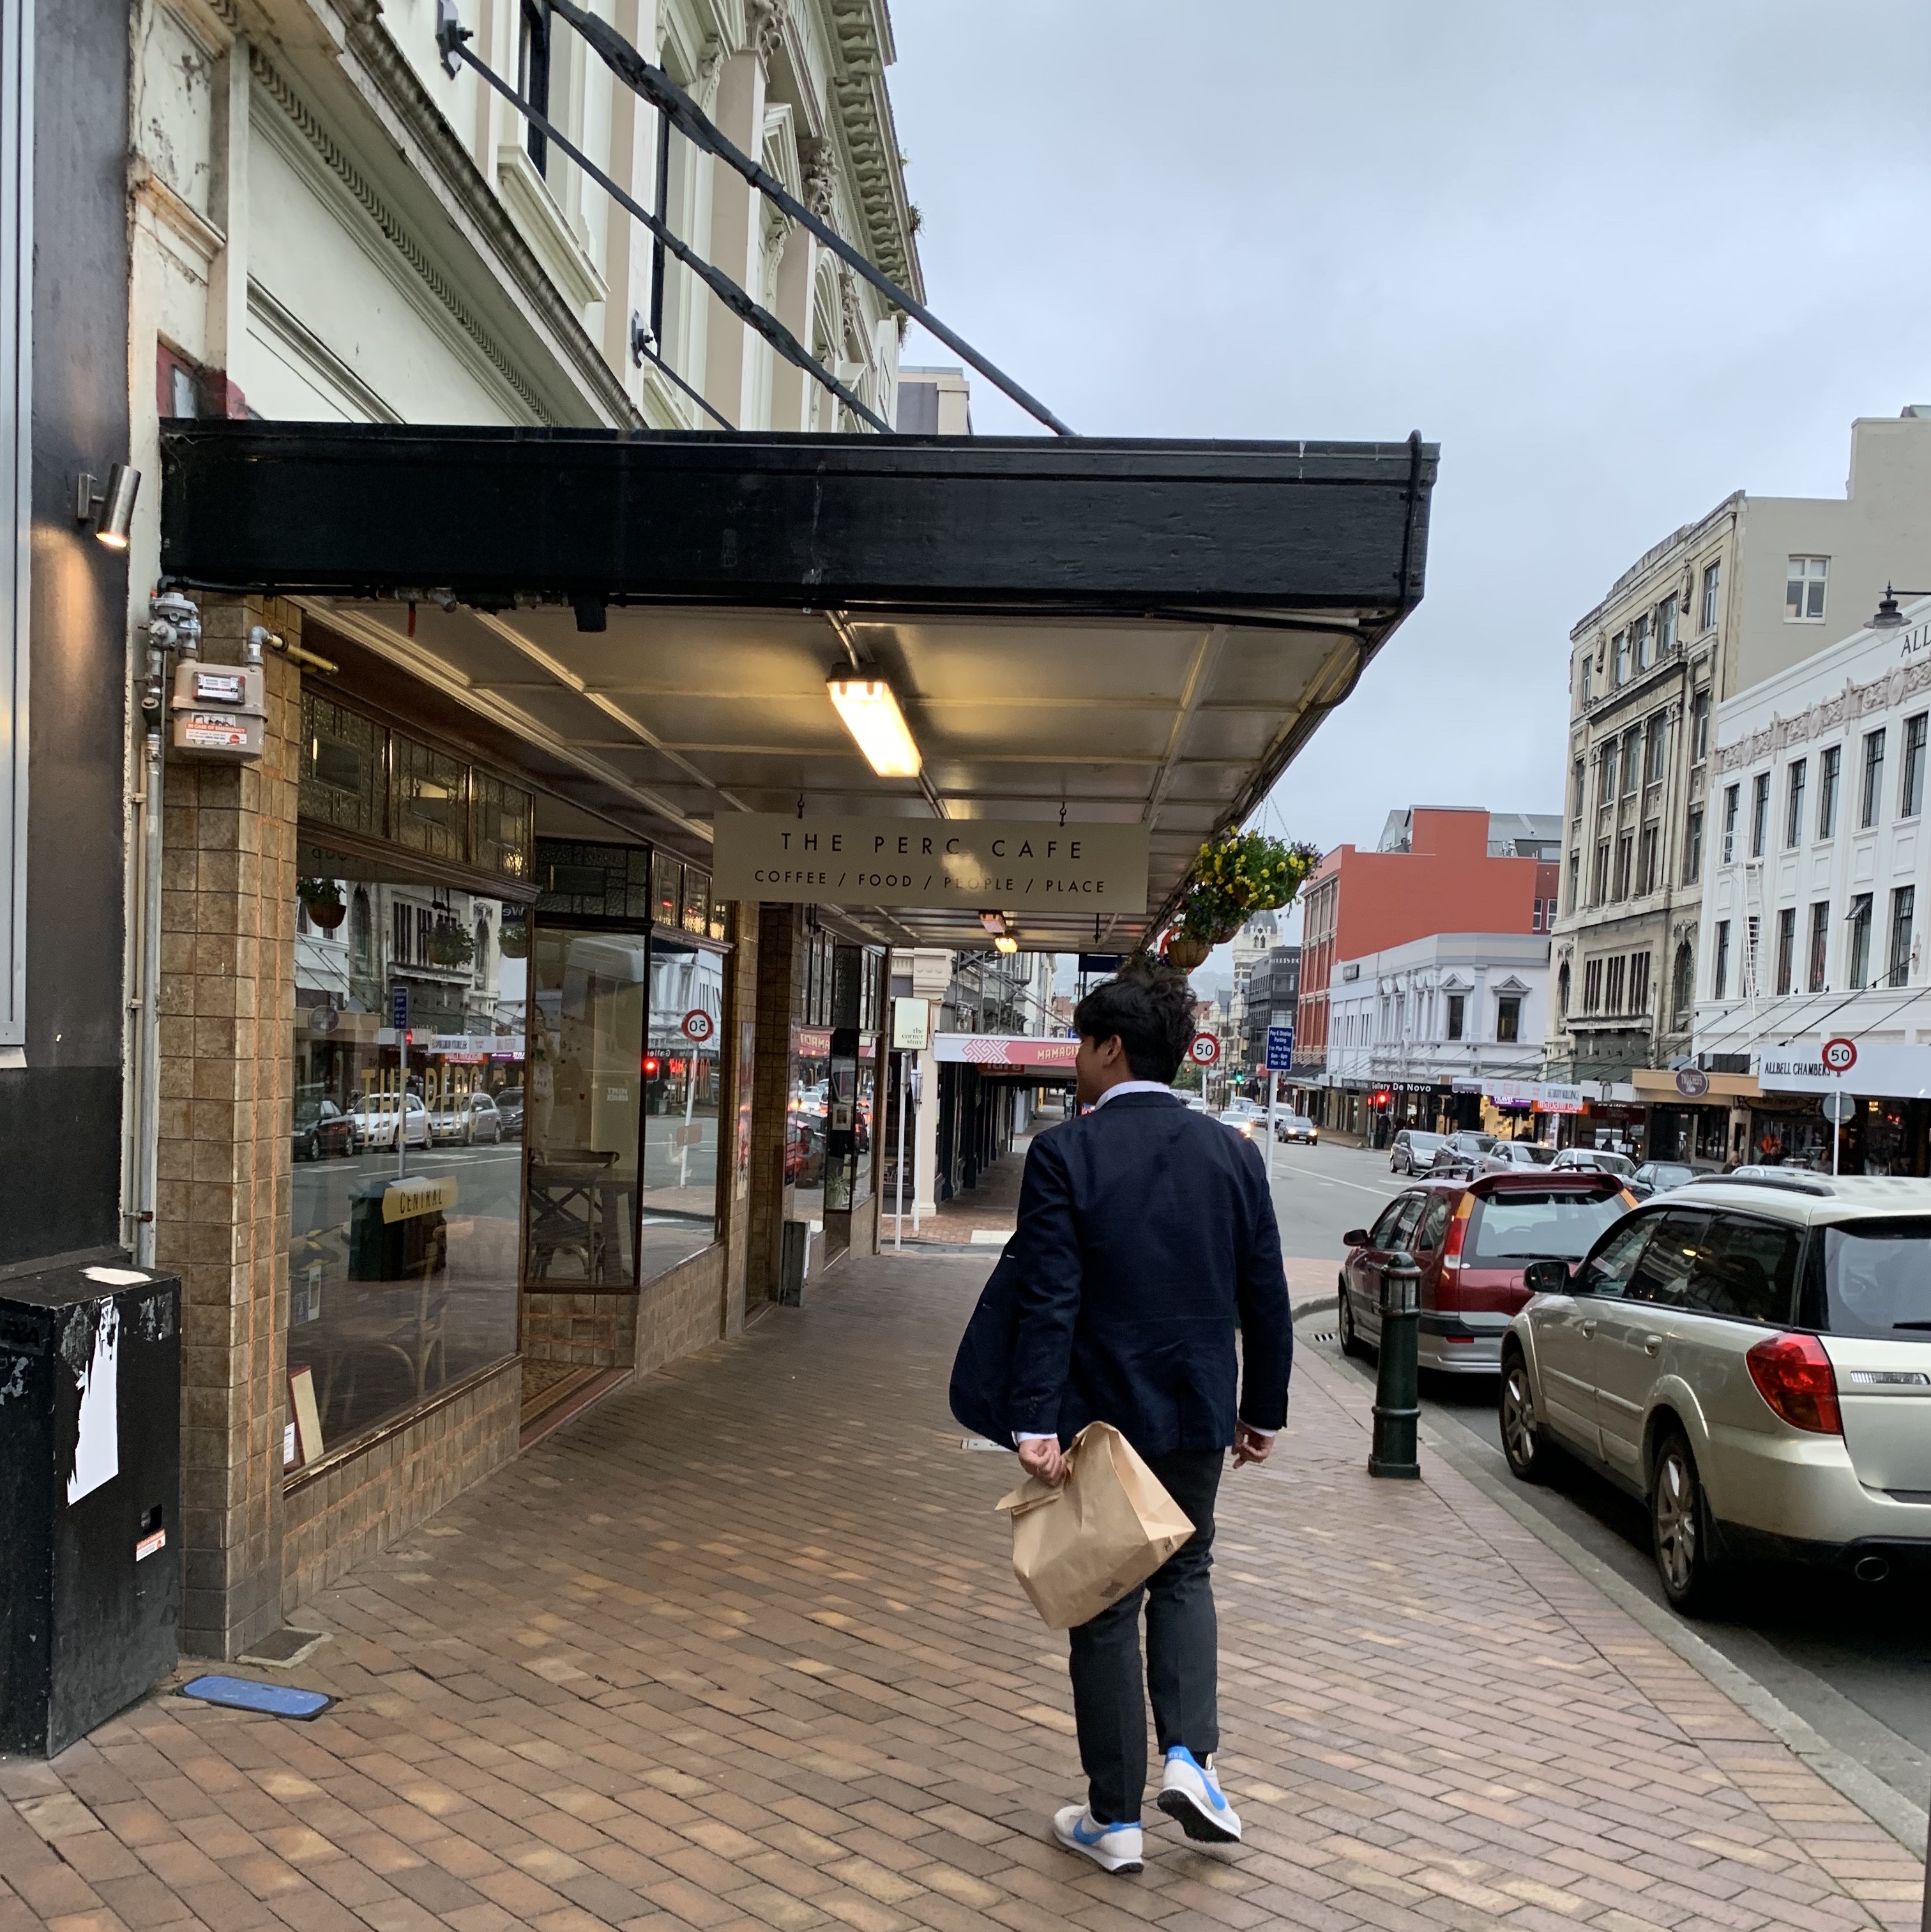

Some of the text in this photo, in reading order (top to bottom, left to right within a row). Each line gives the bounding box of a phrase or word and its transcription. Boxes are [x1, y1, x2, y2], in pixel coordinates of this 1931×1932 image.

[781, 832, 1082, 859] THE PERC CAFE
[754, 869, 826, 885] COFFEE
[858, 874, 912, 888] FOOD
[944, 877, 1014, 892] PEOPLE
[1046, 879, 1105, 894] PLACE
[1195, 1044, 1213, 1056] 50
[1831, 1049, 1850, 1061] 50
[1764, 1062, 1791, 1075] ALLBELL
[1393, 1082, 1404, 1091] De
[1407, 1083, 1432, 1093] Novo
[361, 1066, 480, 1147] THE PERC
[400, 1188, 443, 1213] CENTRAL
